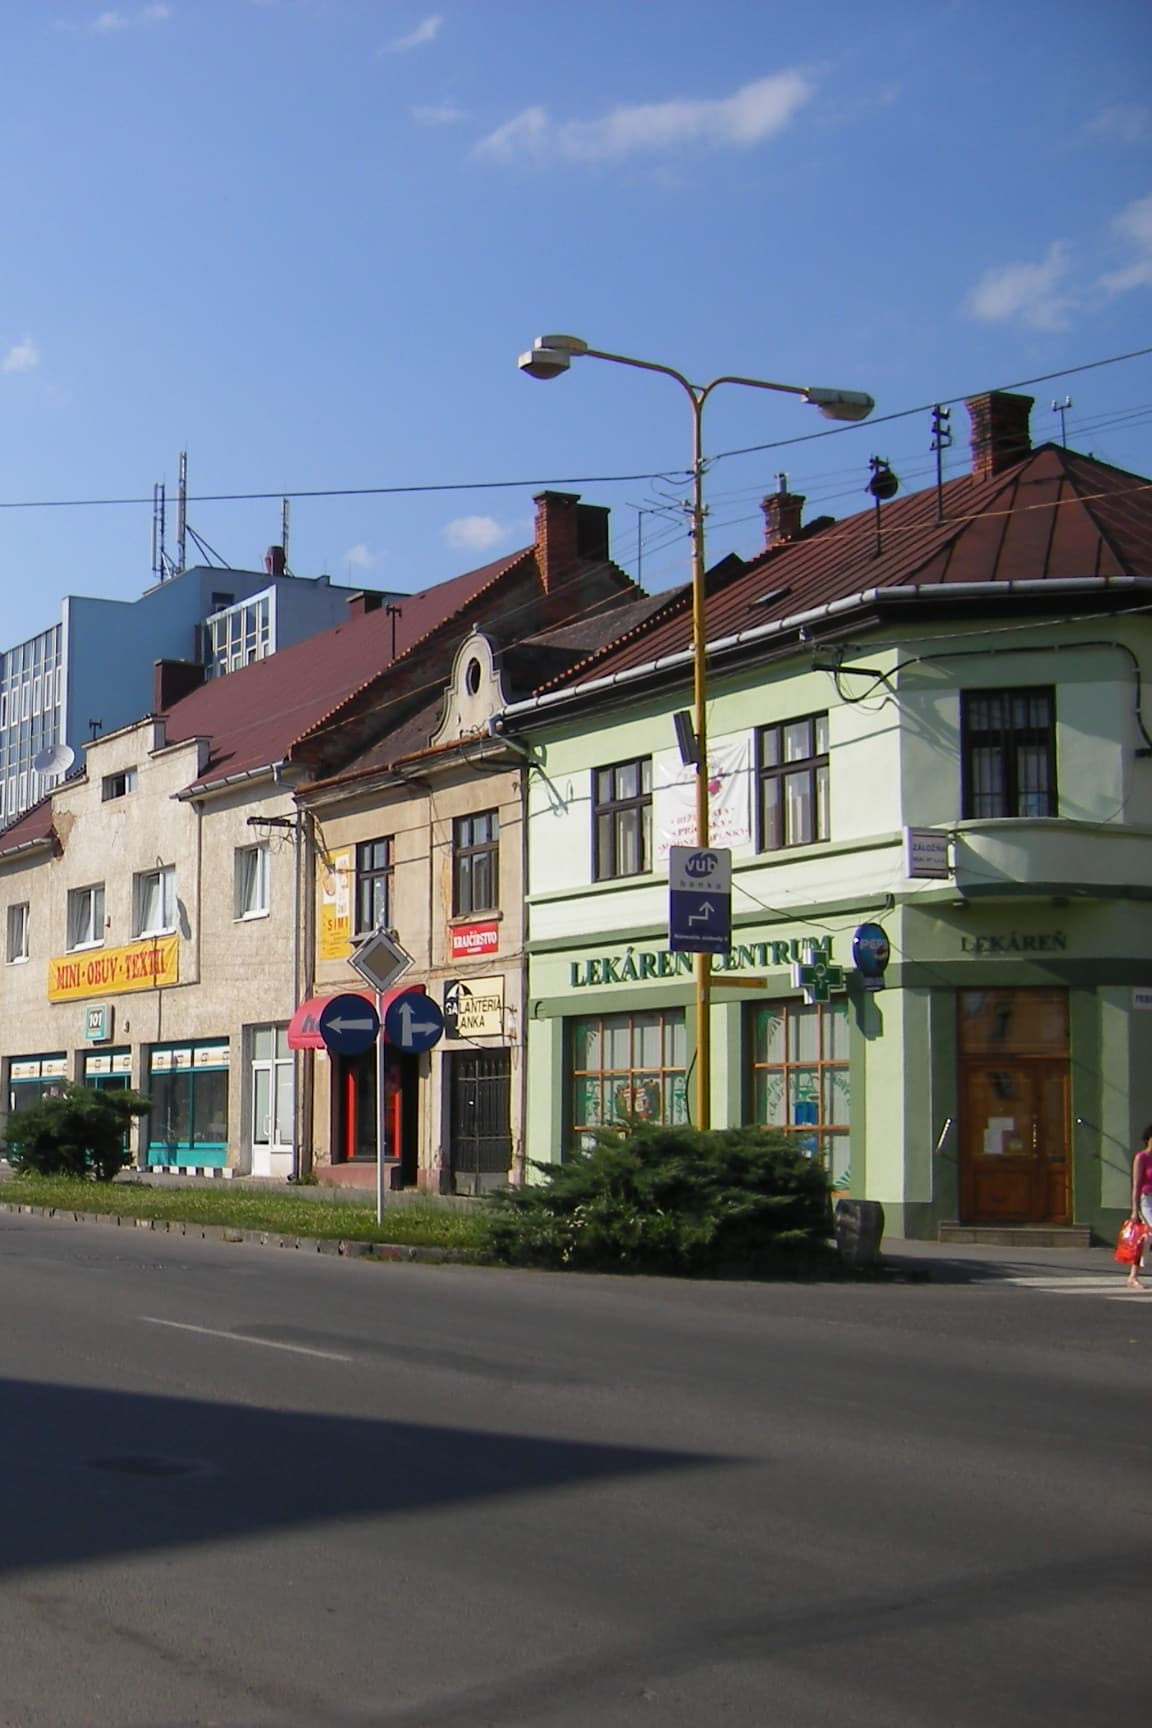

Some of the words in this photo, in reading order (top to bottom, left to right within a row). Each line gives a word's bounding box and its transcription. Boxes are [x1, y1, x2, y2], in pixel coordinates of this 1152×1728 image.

[56, 963, 81, 990] MINI
[87, 957, 118, 986] OBUV
[89, 1012, 103, 1028] 101
